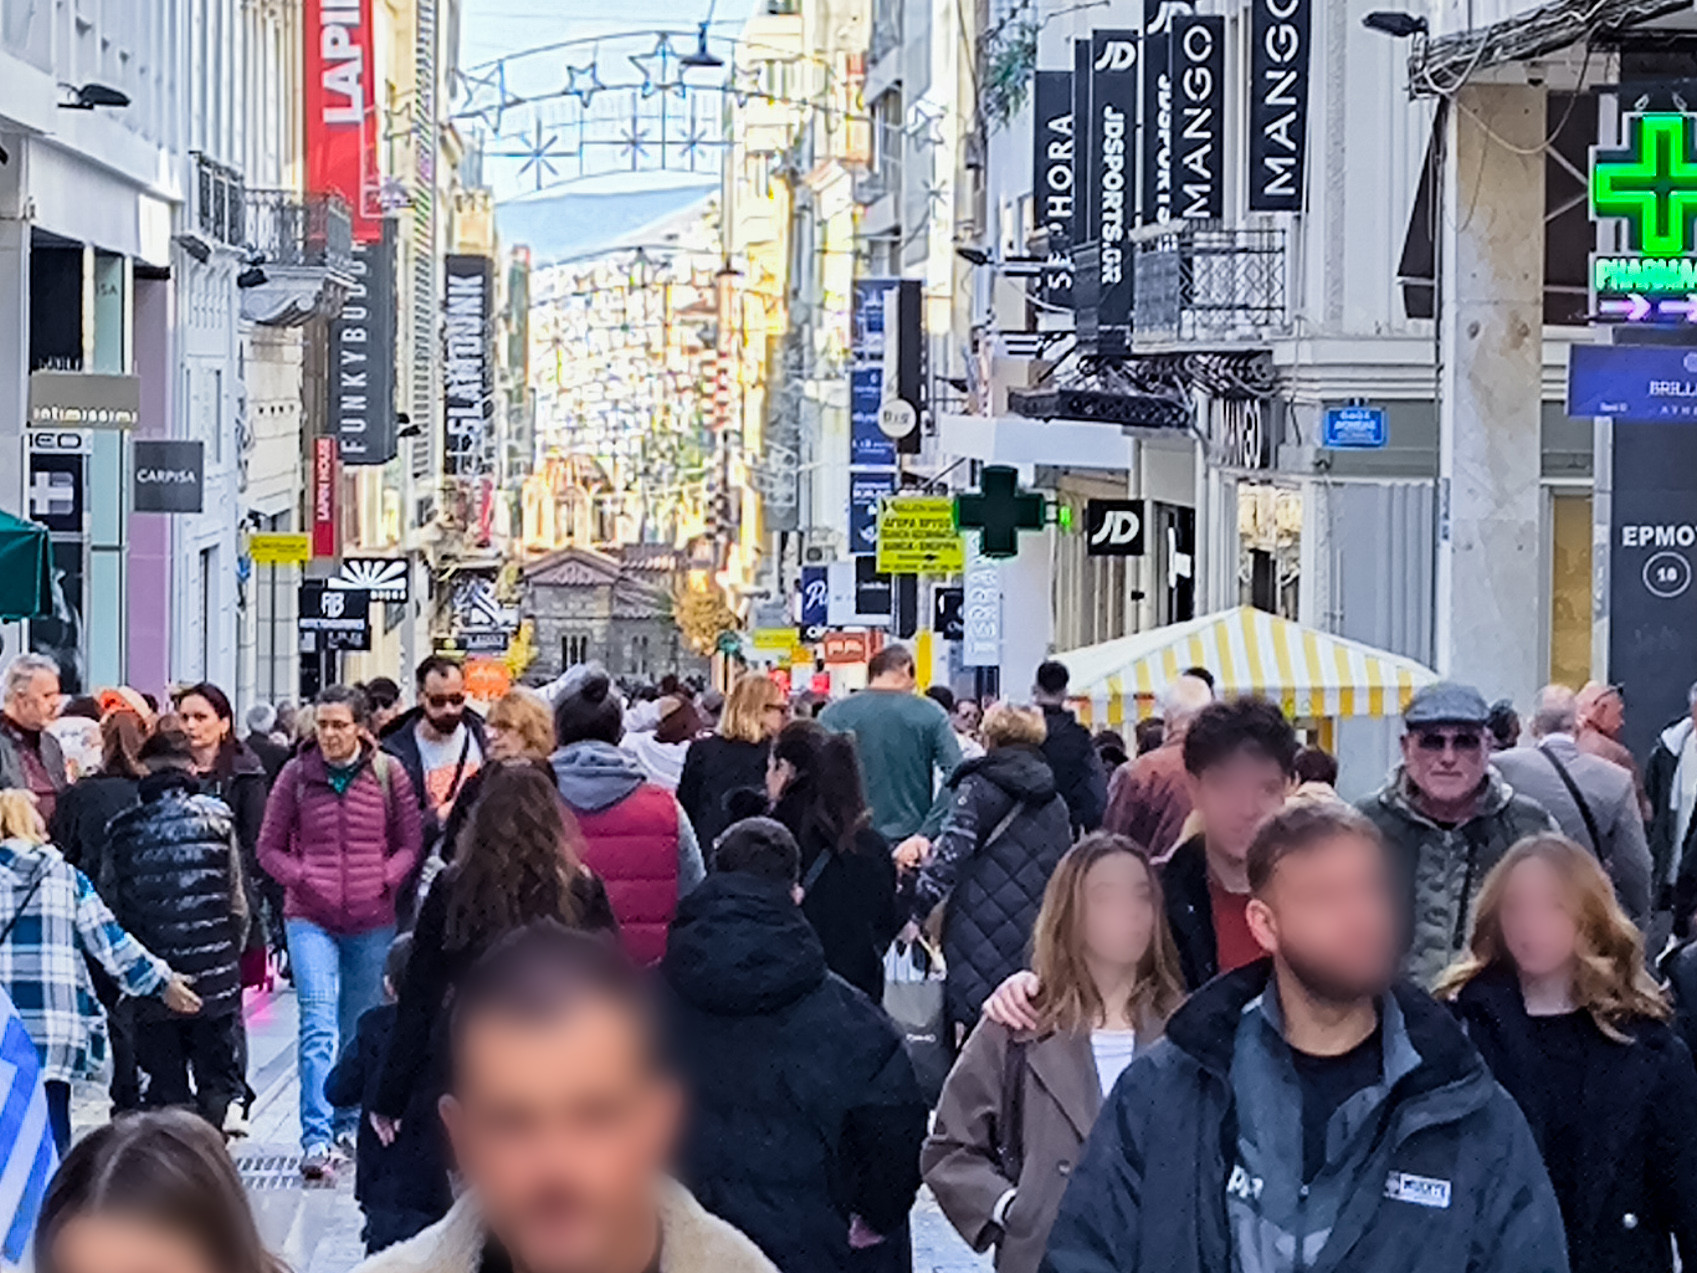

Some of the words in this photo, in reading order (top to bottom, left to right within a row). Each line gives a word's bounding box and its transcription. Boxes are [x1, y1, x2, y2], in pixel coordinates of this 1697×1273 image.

[1094, 40, 1138, 71] JD
[1183, 25, 1213, 218] MANGO
[1047, 113, 1074, 290] SEHORA
[137, 469, 196, 484] CARPISA
[1091, 508, 1141, 548] JD
